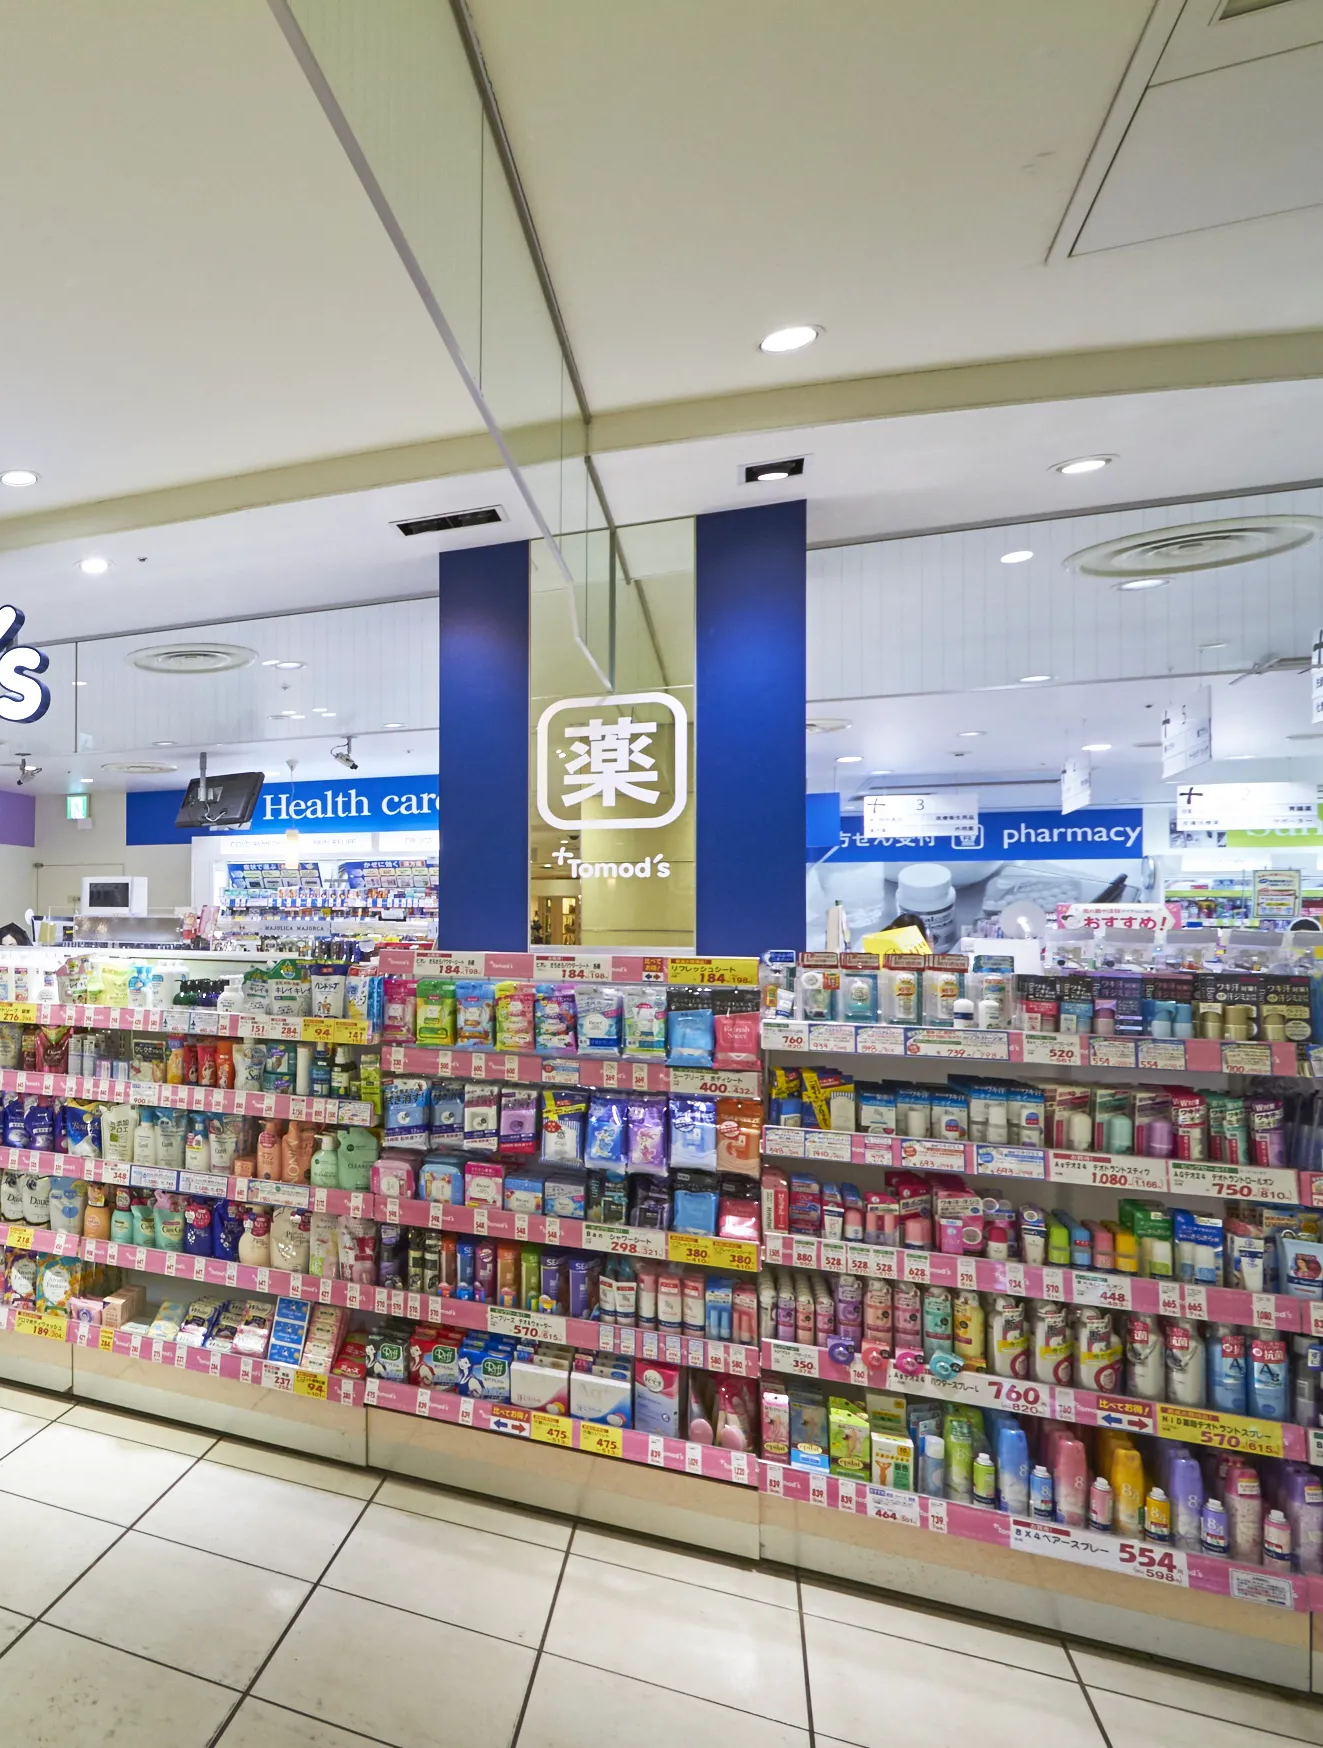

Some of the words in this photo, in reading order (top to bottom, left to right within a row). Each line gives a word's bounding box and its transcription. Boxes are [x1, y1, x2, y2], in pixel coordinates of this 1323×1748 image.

[561, 717, 661, 807] 薬
[263, 789, 371, 820] Health
[381, 792, 440, 816] car
[916, 799, 925, 811] 3
[1003, 823, 1142, 849] pharmacy
[567, 853, 671, 878] Tomod's
[439, 965, 460, 974] 184
[561, 969, 584, 978] 184
[671, 965, 736, 973] リフレッシュシート
[699, 973, 726, 984] 184
[1216, 982, 1238, 992] ワキ汗
[1267, 984, 1290, 993] ワキ汗
[4, 1013, 20, 1022] 276
[251, 1025, 266, 1033] 151
[280, 1027, 298, 1035] 284
[314, 1028, 330, 1036] 94
[348, 1032, 364, 1040] 141
[782, 1036, 803, 1044] 760
[948, 1048, 965, 1058] 739
[1049, 1048, 1074, 1058] 520
[673, 1073, 705, 1081] シーブリーズ
[699, 1082, 728, 1094] 400
[113, 1172, 127, 1180] 348
[1212, 1182, 1253, 1198] 750
[16, 1236, 30, 1244] 218
[586, 1231, 603, 1239] Ban
[609, 1233, 652, 1245] シャワーシート
[611, 1241, 637, 1254] 298
[686, 1248, 708, 1258] 380
[729, 1254, 752, 1265] 380
[796, 1252, 813, 1263] 880
[825, 1256, 842, 1266] 528
[851, 1260, 868, 1270] 528
[876, 1262, 893, 1272] 528
[908, 1268, 926, 1278] 628
[1100, 1292, 1126, 1303] 448
[33, 1325, 49, 1336] 189
[513, 1325, 539, 1338] 570
[382, 1346, 401, 1361] Riff
[434, 1348, 453, 1361] Riff
[484, 1361, 505, 1376] Riff
[792, 1360, 814, 1370] 350
[274, 1376, 290, 1386] 237
[307, 1384, 323, 1393] 94
[987, 1381, 1040, 1406] 760
[1011, 1403, 1037, 1415] 820
[1098, 1398, 1150, 1417] 比べてお得!
[492, 1406, 529, 1421] 比べてお得!
[546, 1428, 567, 1440] 475
[596, 1438, 618, 1450] 475
[1200, 1431, 1241, 1448] 570
[1247, 1442, 1274, 1454] 615
[766, 1444, 786, 1453] epilat
[799, 1443, 821, 1454] epilat
[840, 1458, 862, 1470] epilat
[768, 1478, 780, 1489] 839
[812, 1488, 824, 1498] 839
[840, 1494, 853, 1504] 839
[875, 1509, 898, 1521] 464
[931, 1514, 944, 1526] 739
[1118, 1542, 1177, 1573] 554
[1146, 1569, 1175, 1582] 598
